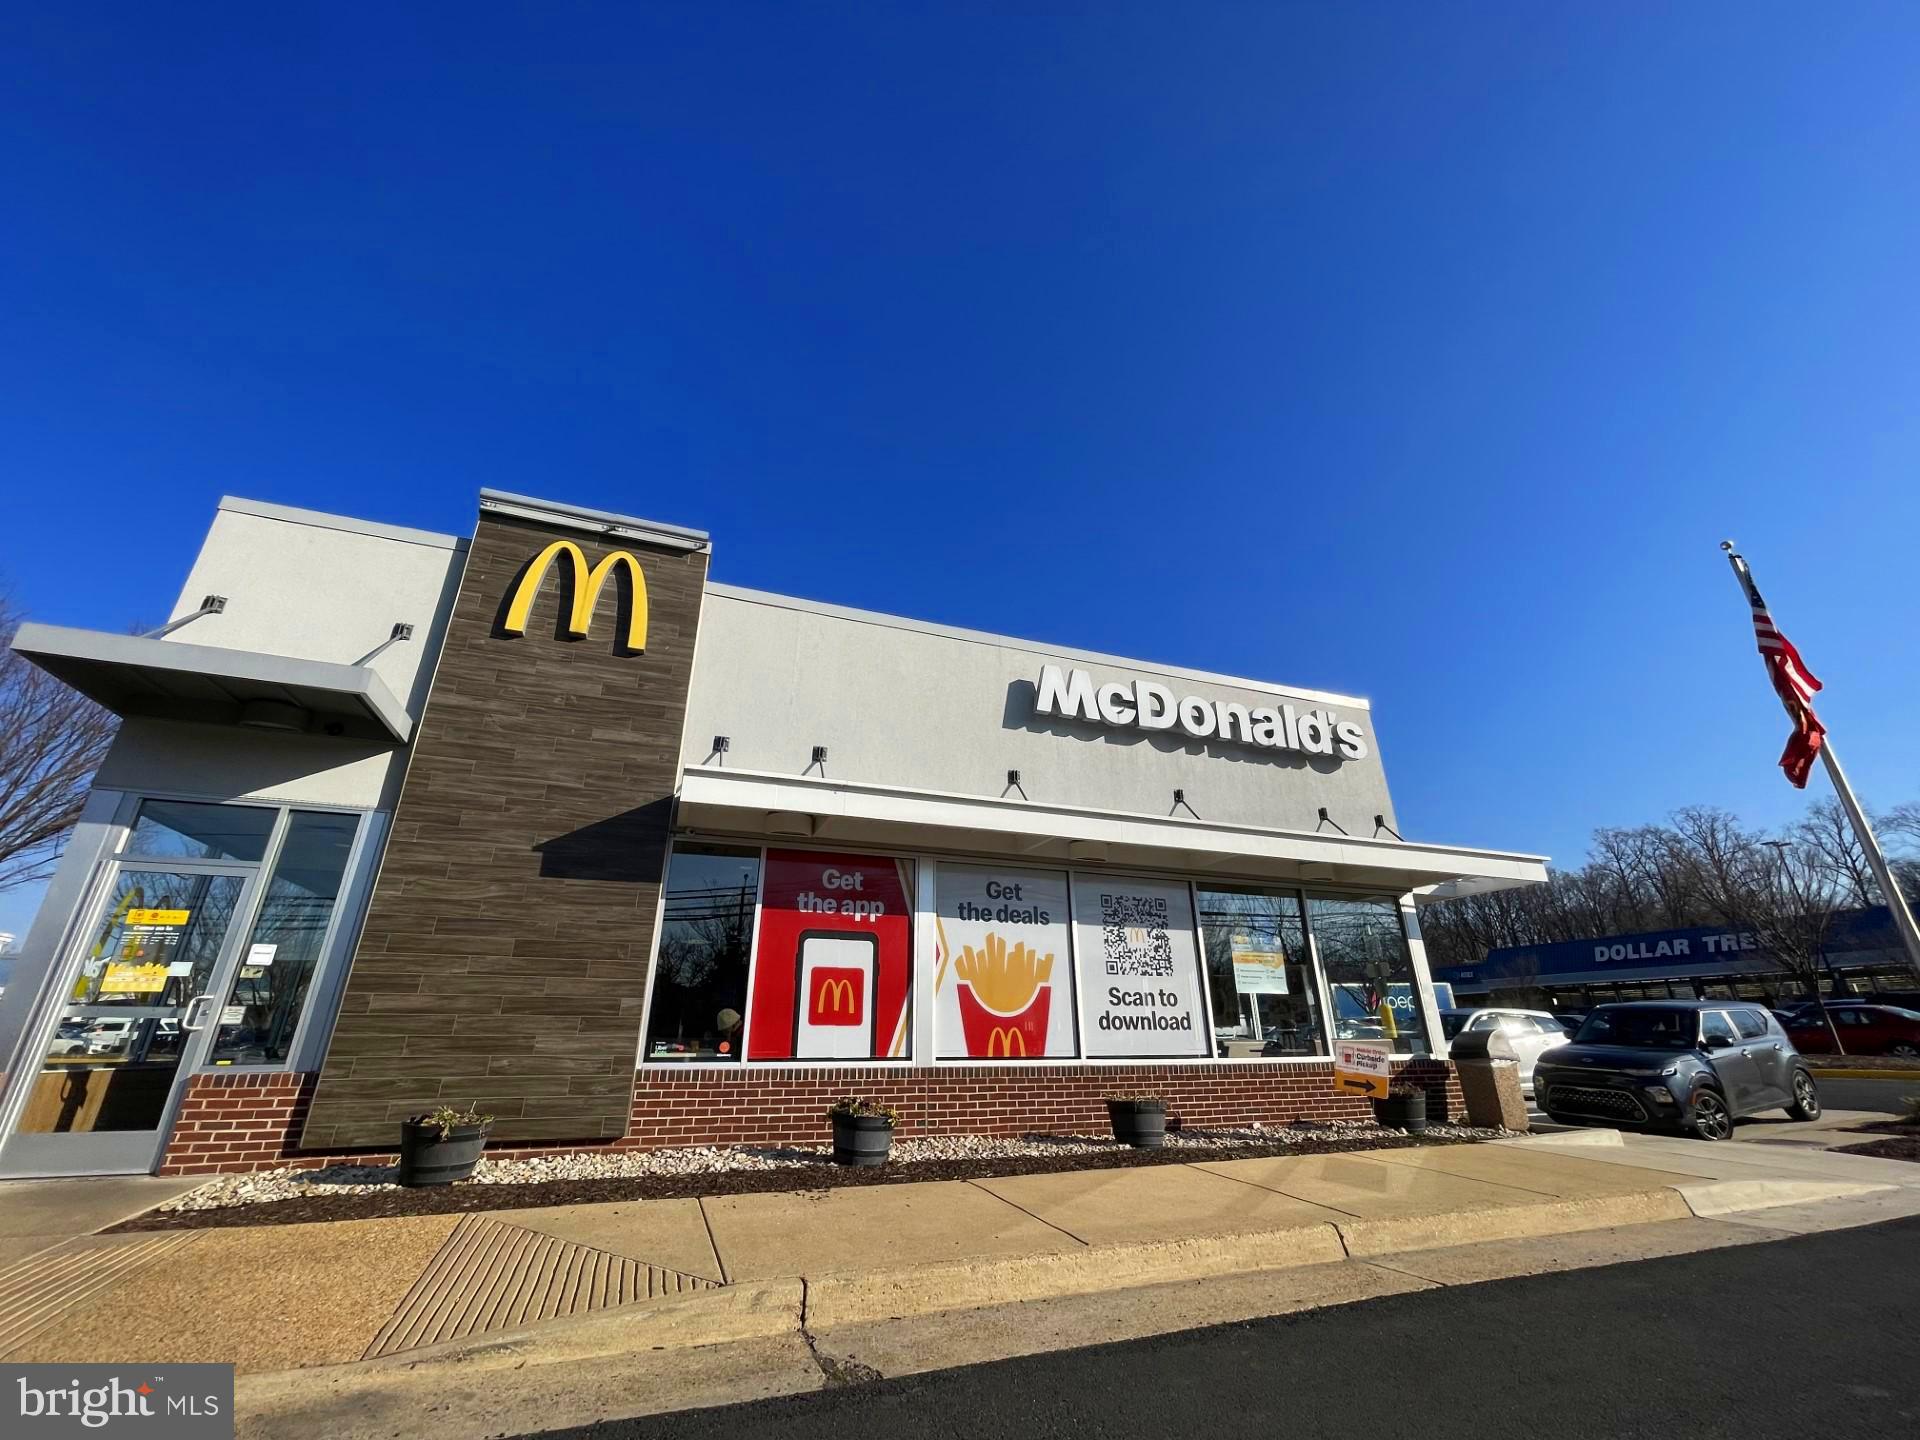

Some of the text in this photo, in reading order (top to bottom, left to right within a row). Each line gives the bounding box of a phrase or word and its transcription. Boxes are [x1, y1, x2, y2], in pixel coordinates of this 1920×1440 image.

[1035, 664, 1369, 762] McDonald's
[822, 868, 864, 891] Get
[985, 880, 1022, 901] Get
[797, 891, 885, 922] the app
[958, 902, 1050, 925] the deals
[1594, 938, 1691, 962] DOLLAR
[1108, 986, 1178, 1007] Scan to
[1098, 1010, 1192, 1031] download
[1356, 1052, 1386, 1064] Curbside
[1356, 1061, 1378, 1070] Pickup
